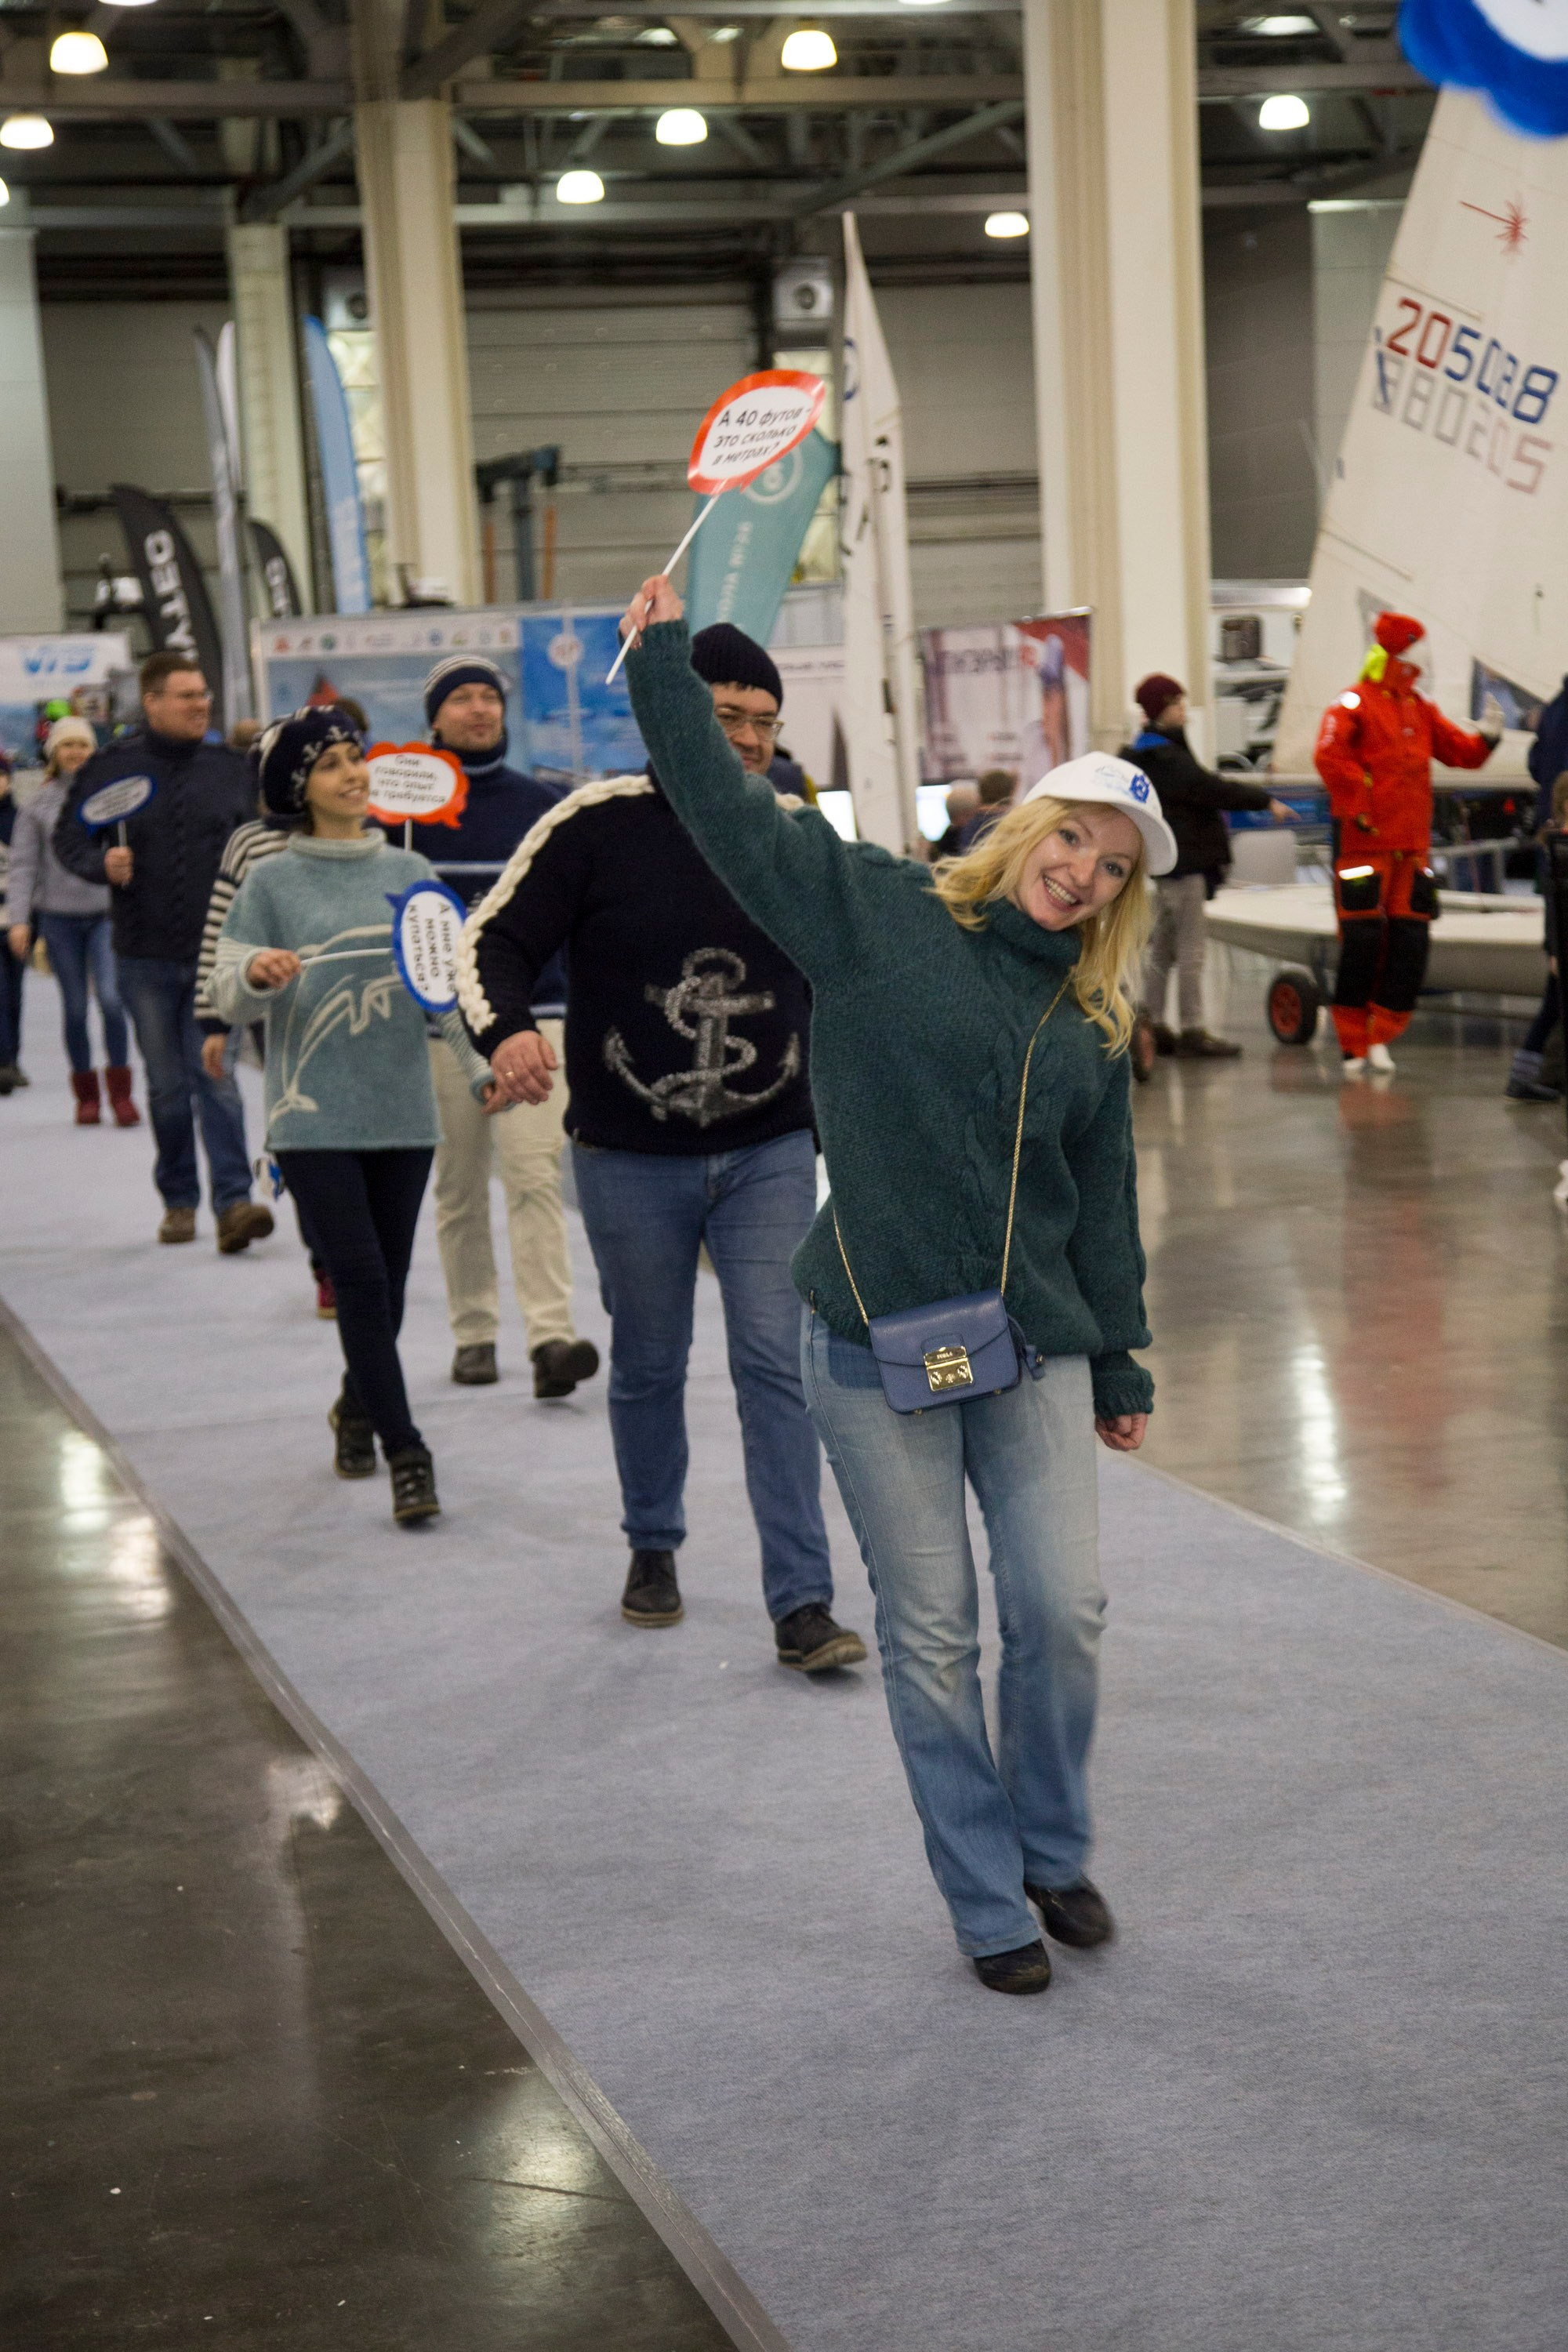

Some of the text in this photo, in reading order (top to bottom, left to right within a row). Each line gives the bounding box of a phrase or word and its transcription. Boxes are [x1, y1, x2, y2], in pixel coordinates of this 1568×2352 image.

[713, 425, 797, 448] это сколько
[717, 409, 729, 427] А
[735, 409, 757, 426] 40
[759, 406, 804, 426] футов
[712, 441, 781, 466] в метрах?
[406, 904, 429, 992] купаться?
[426, 918, 440, 978] можно
[439, 902, 458, 993] А мне уже
